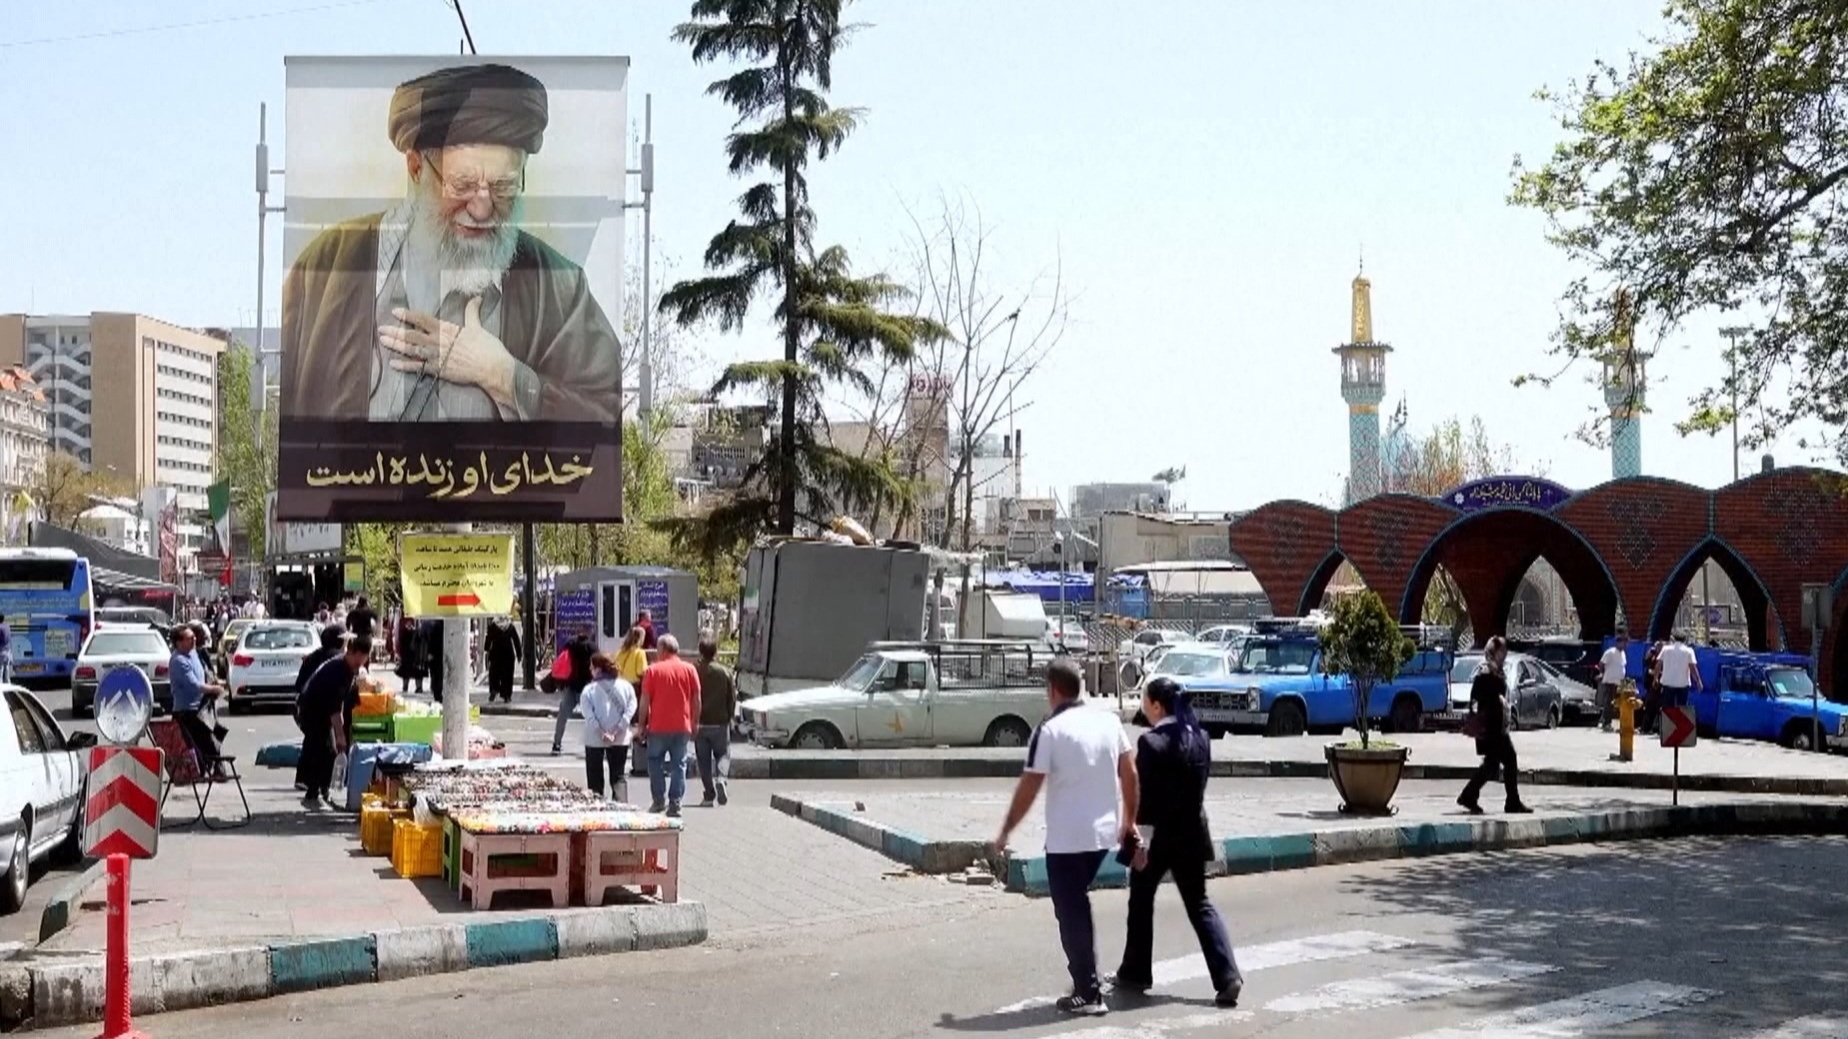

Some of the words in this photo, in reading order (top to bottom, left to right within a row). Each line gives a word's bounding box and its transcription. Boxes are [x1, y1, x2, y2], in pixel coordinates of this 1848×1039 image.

[306, 451, 384, 488] است
[389, 453, 455, 499] زنده
[449, 450, 488, 499] او
[491, 451, 593, 495] خدای
